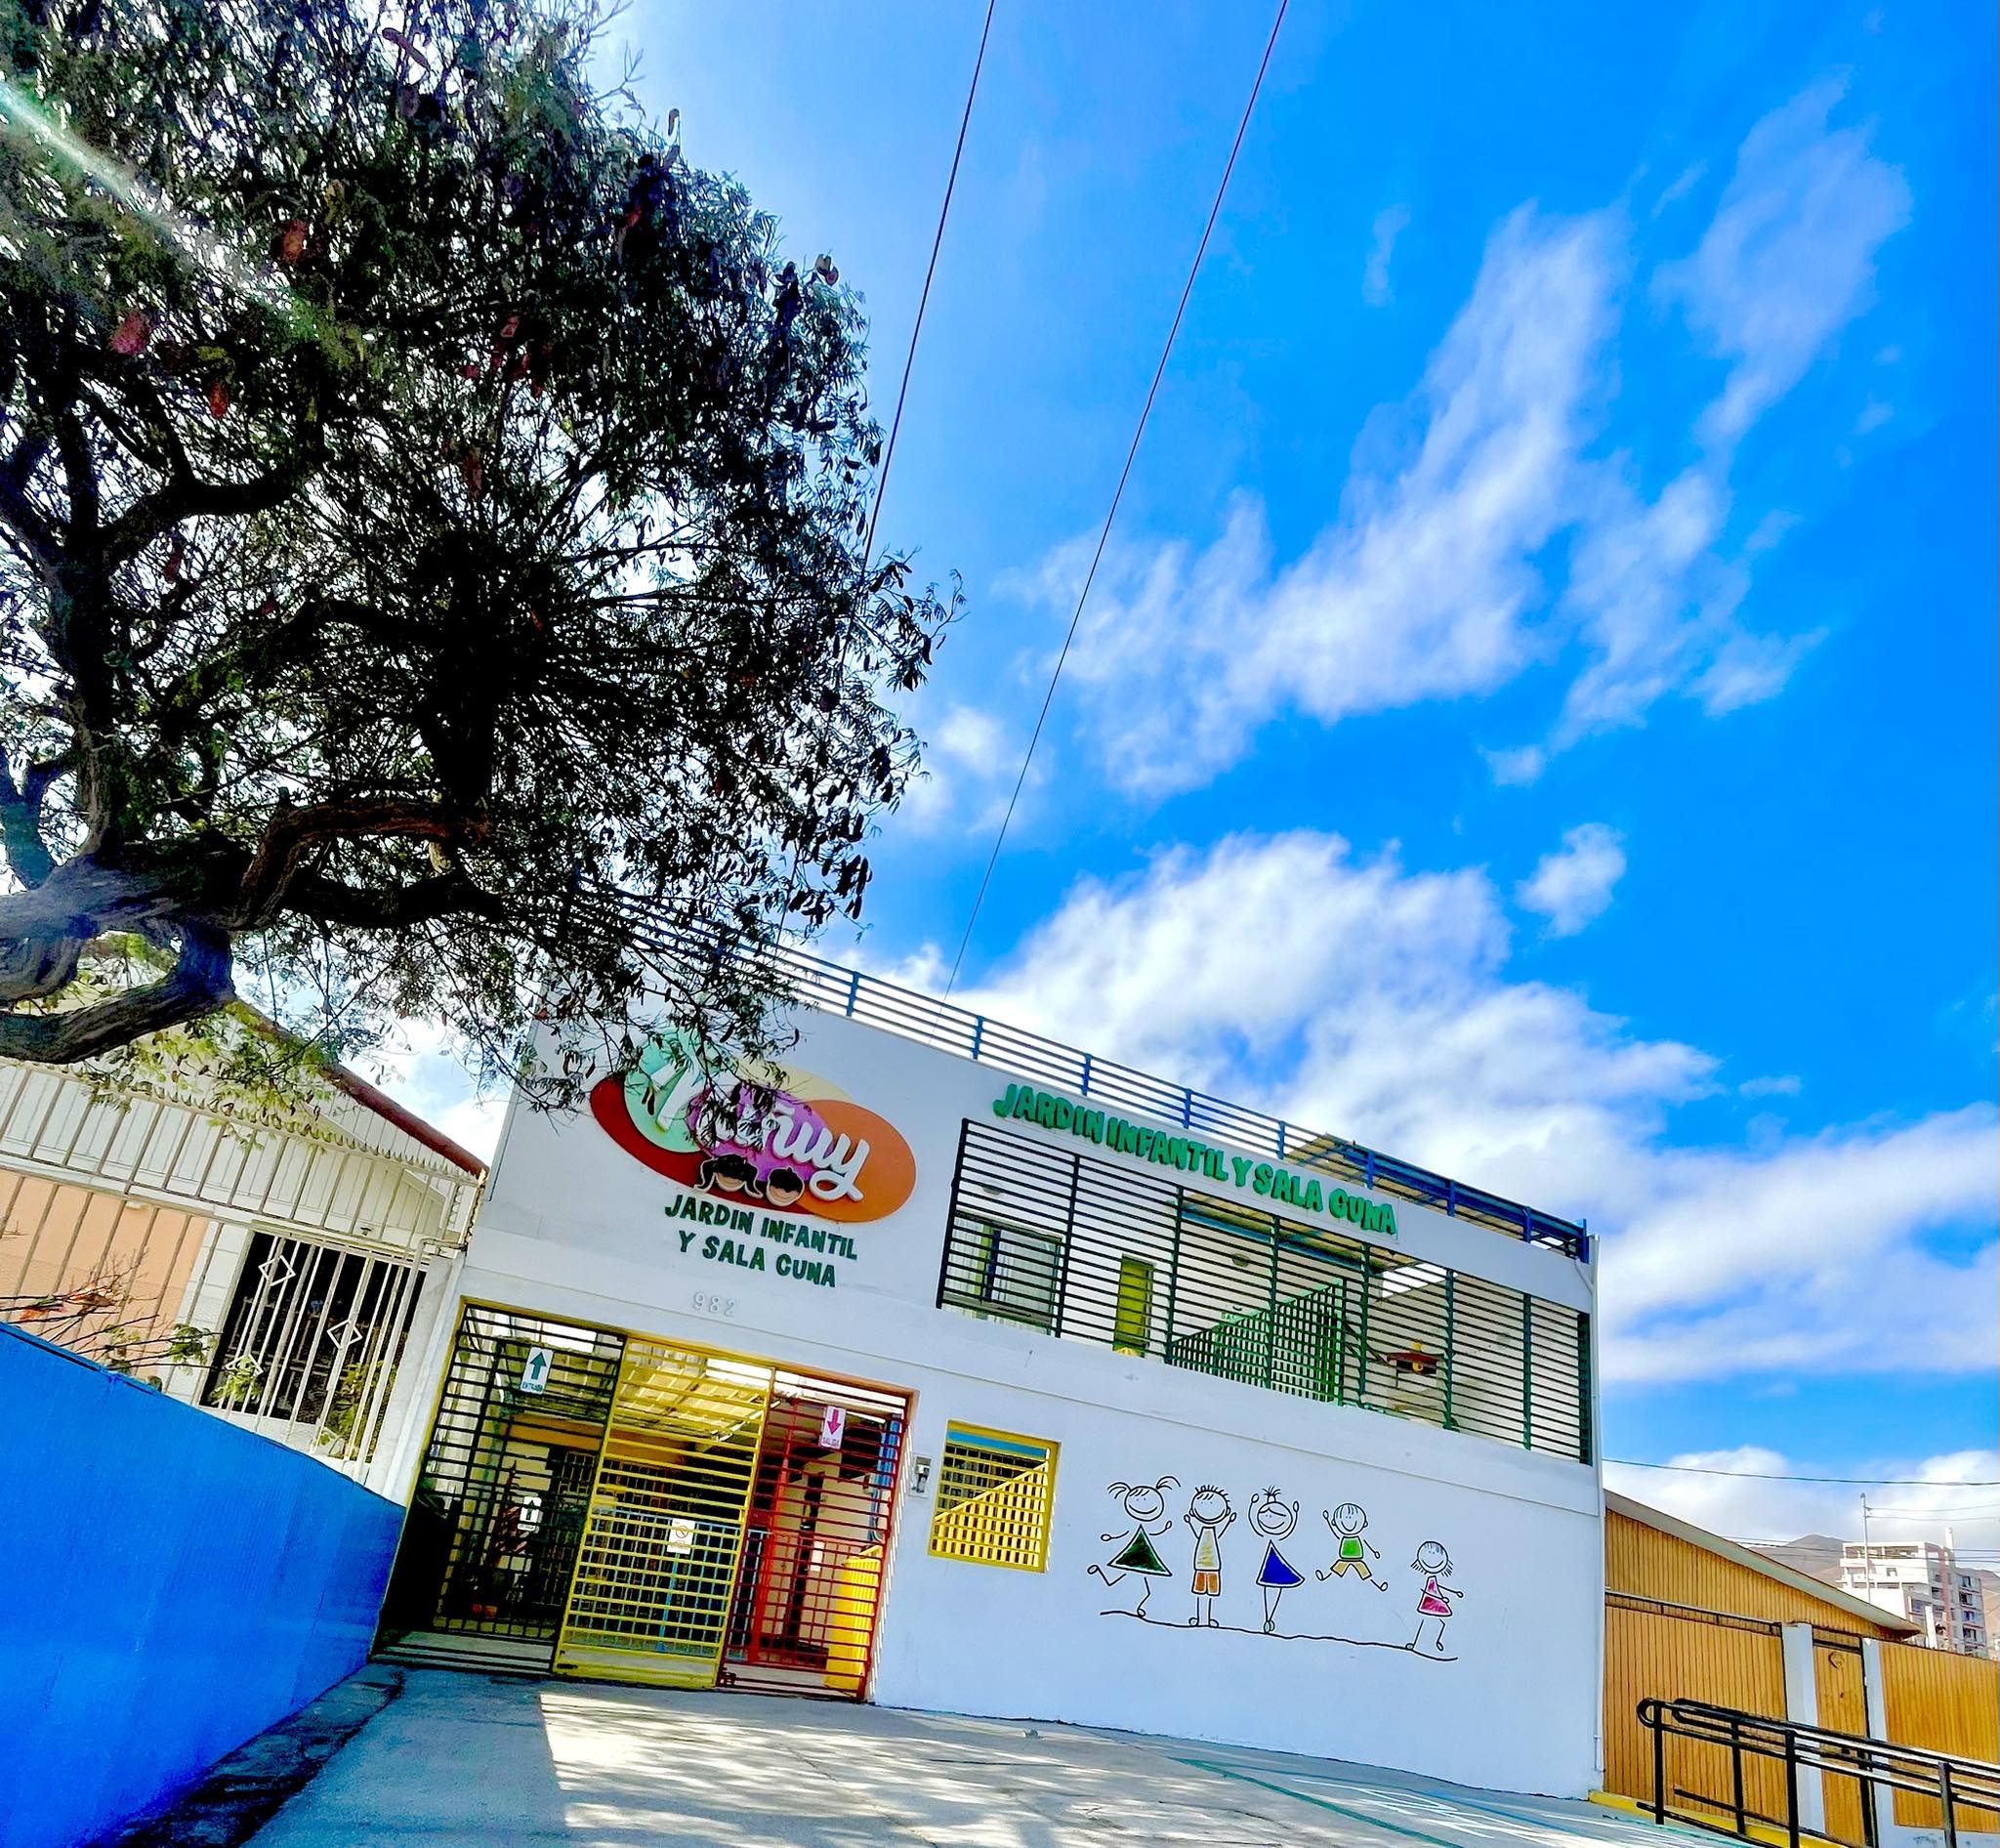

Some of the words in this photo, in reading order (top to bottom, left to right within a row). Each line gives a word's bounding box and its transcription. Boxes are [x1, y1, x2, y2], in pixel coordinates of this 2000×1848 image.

[993, 1083, 1104, 1144] JARDIN
[1106, 1116, 1229, 1182] INFANTIL
[1231, 1156, 1253, 1188] Y
[1253, 1162, 1323, 1212] SALA
[1328, 1188, 1396, 1236] CUNA
[664, 1195, 754, 1235] JARDIN
[761, 1217, 858, 1261] INFANTIL
[678, 1230, 697, 1253] Y
[702, 1236, 765, 1272] SALA
[775, 1253, 836, 1288] CUNA
[692, 1290, 735, 1318] 982
